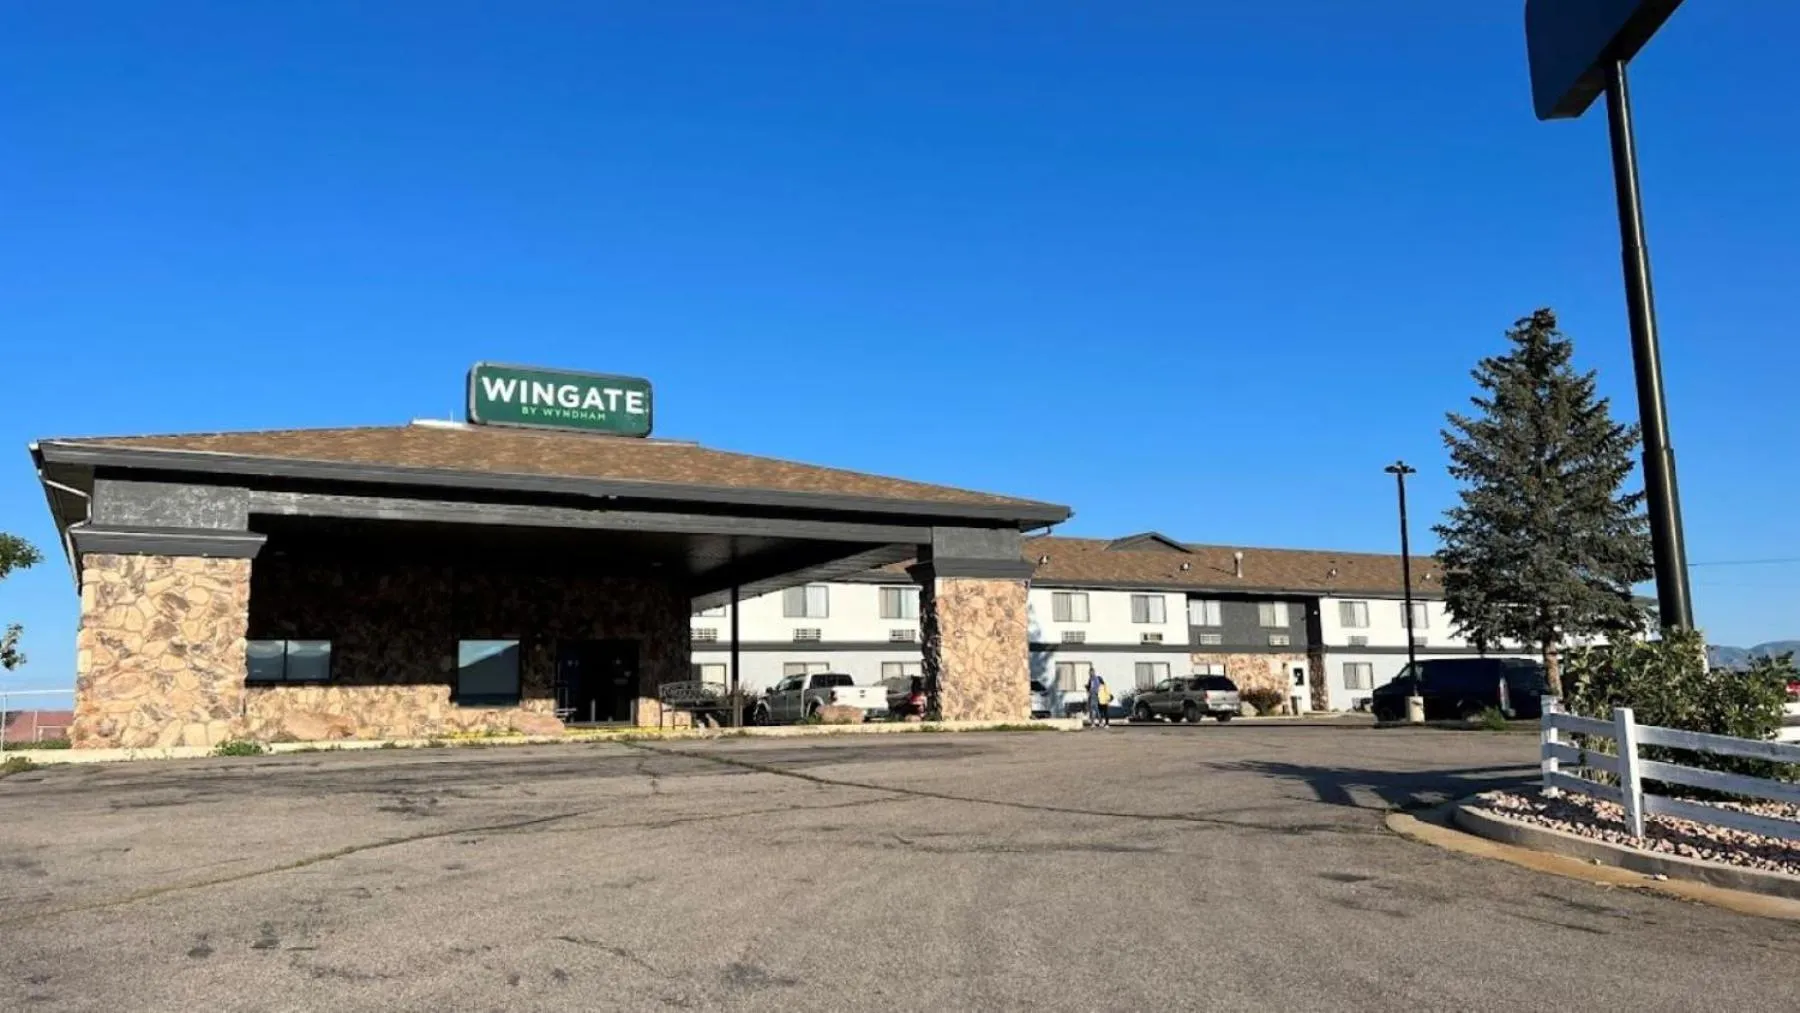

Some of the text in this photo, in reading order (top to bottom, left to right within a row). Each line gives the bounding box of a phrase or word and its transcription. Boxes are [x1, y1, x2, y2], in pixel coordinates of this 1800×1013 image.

[482, 376, 644, 414] WINGATE
[521, 407, 606, 421] BY WYNDHAM
